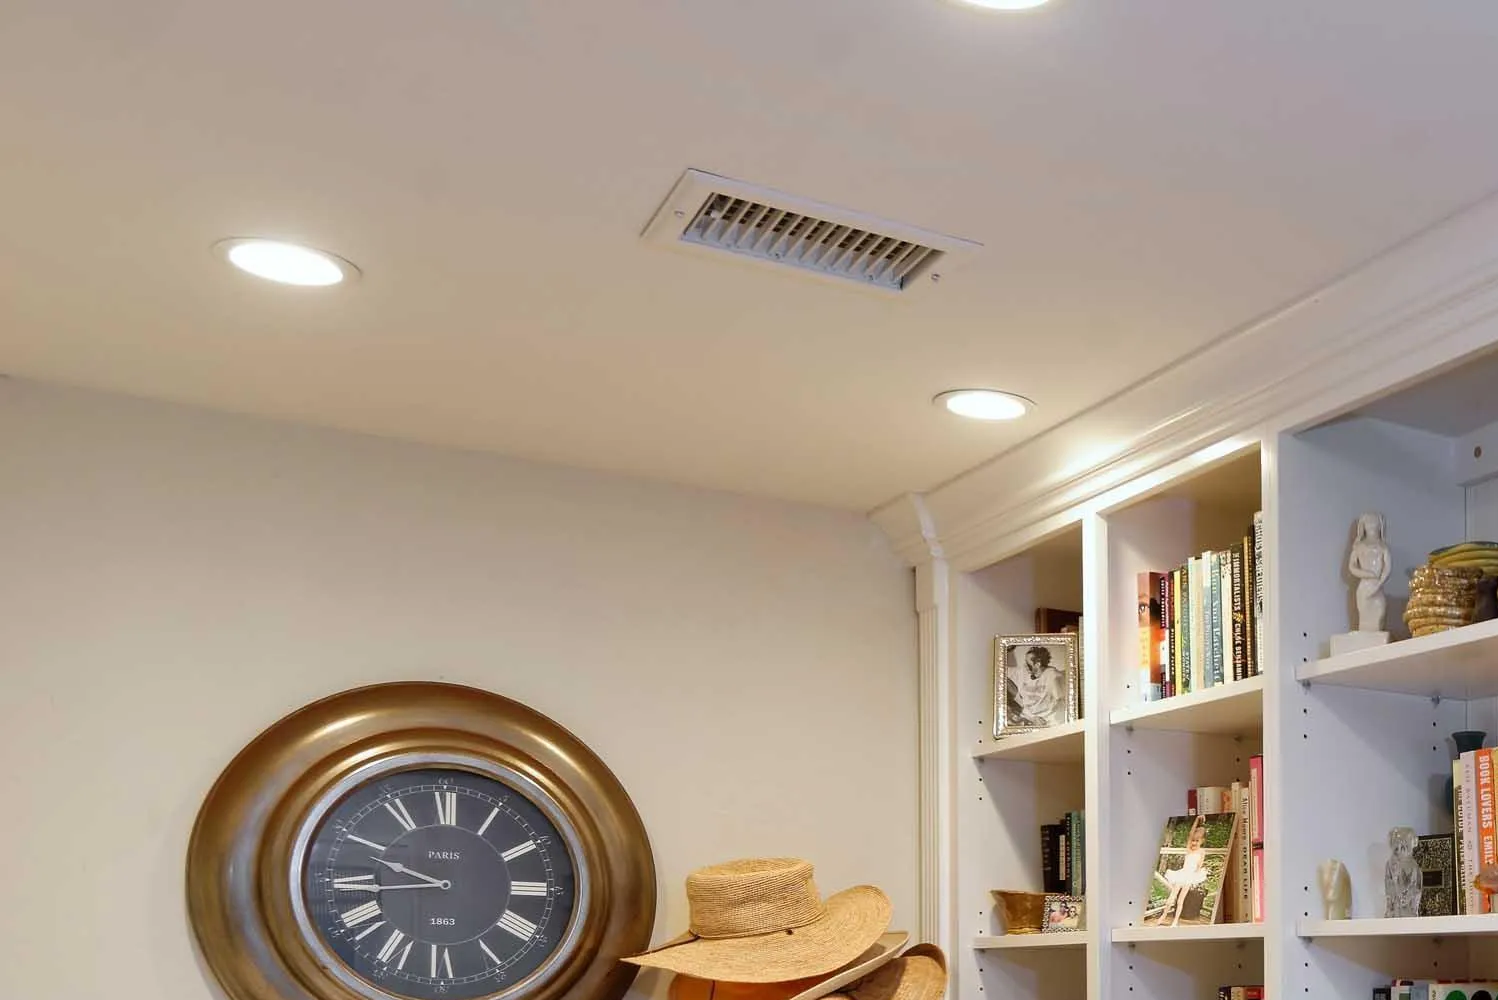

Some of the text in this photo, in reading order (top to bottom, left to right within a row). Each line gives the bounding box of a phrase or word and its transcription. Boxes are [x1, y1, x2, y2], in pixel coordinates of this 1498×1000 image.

[1478, 755, 1491, 785] BOOK
[1480, 788, 1493, 829] LOVERS
[428, 851, 460, 860] PARIS
[430, 917, 456, 926] 1863
